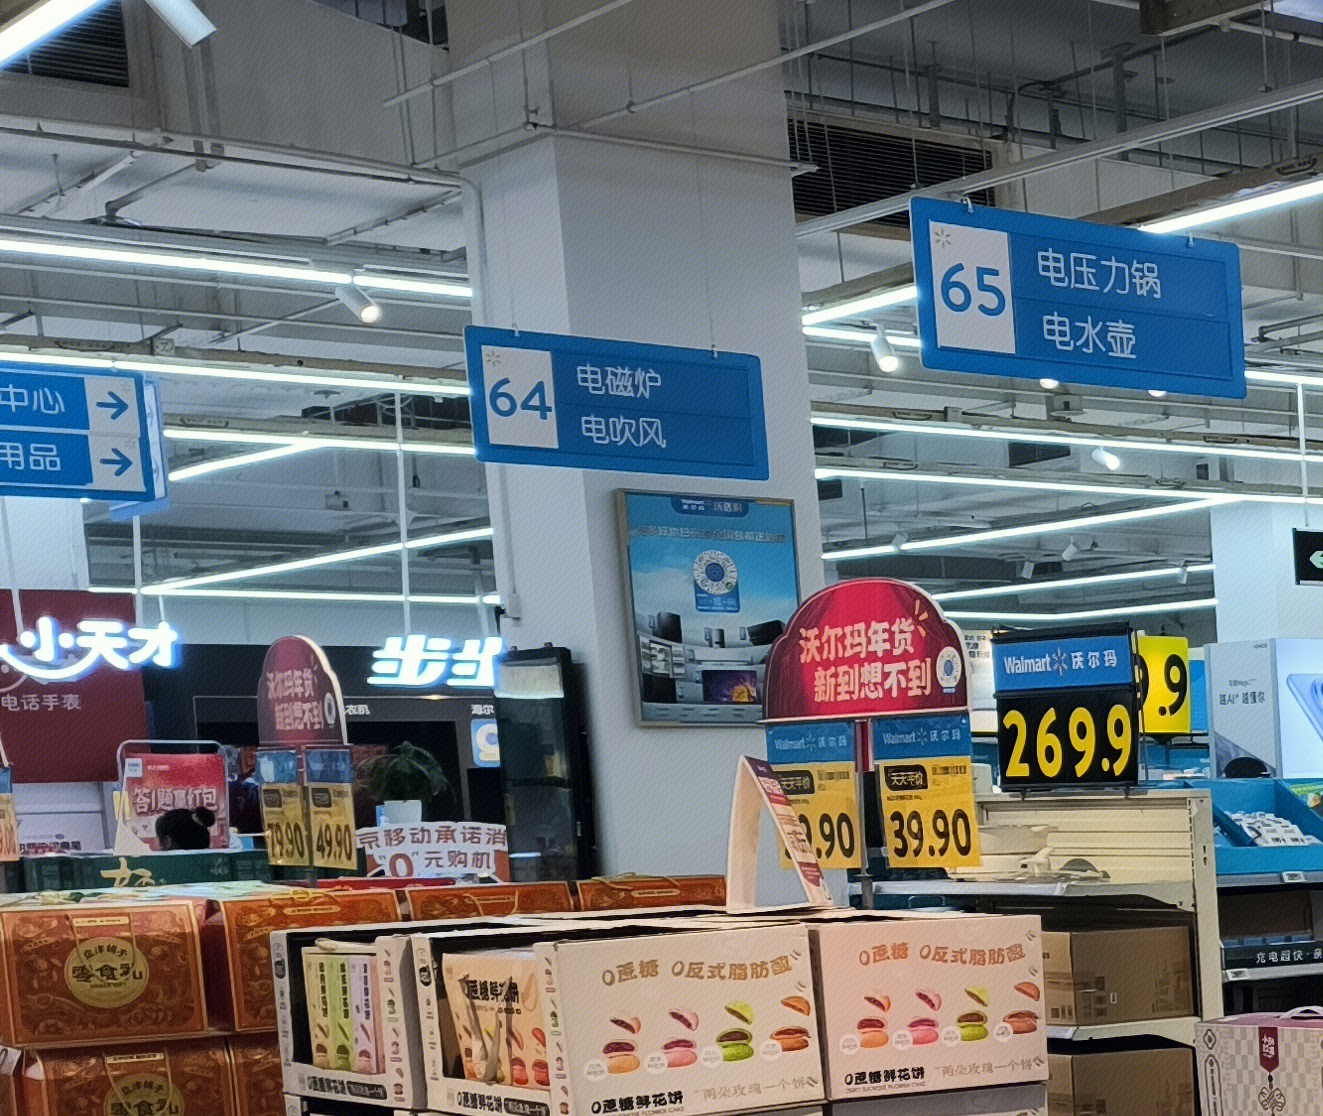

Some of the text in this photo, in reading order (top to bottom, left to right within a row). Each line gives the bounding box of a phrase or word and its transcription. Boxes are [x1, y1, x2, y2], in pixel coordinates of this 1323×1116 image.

[941, 262, 1006, 317] 65
[1038, 247, 1162, 298] 电压力锅
[1043, 311, 1137, 359] 电水壶
[577, 364, 661, 398] 电磁炉
[0, 384, 65, 414] 中心
[489, 377, 552, 420] 64
[581, 414, 666, 448] 电吹风
[0, 443, 61, 470] 用品
[18, 616, 178, 670] 小天才
[799, 618, 915, 663] 沃尔玛年货
[1003, 650, 1117, 675] Walmart 沃尔玛
[814, 658, 931, 703] 新到想不到
[1, 693, 82, 711] 电话手表
[343, 705, 370, 715] 衣机
[774, 738, 805, 750] Walmart
[883, 731, 915, 744] Walmart
[1003, 704, 1132, 777] 269.9
[315, 823, 351, 861] 49.90
[890, 809, 971, 858] 39.90
[602, 955, 793, 987] 0蔗糖 0反式脂肪酸
[859, 942, 1026, 966] 0蔗糖 0反式脂肪酸
[844, 1067, 924, 1086] 0蔗糖鲜花饼
[592, 1090, 683, 1114] 0蔗糖鲜花饼
